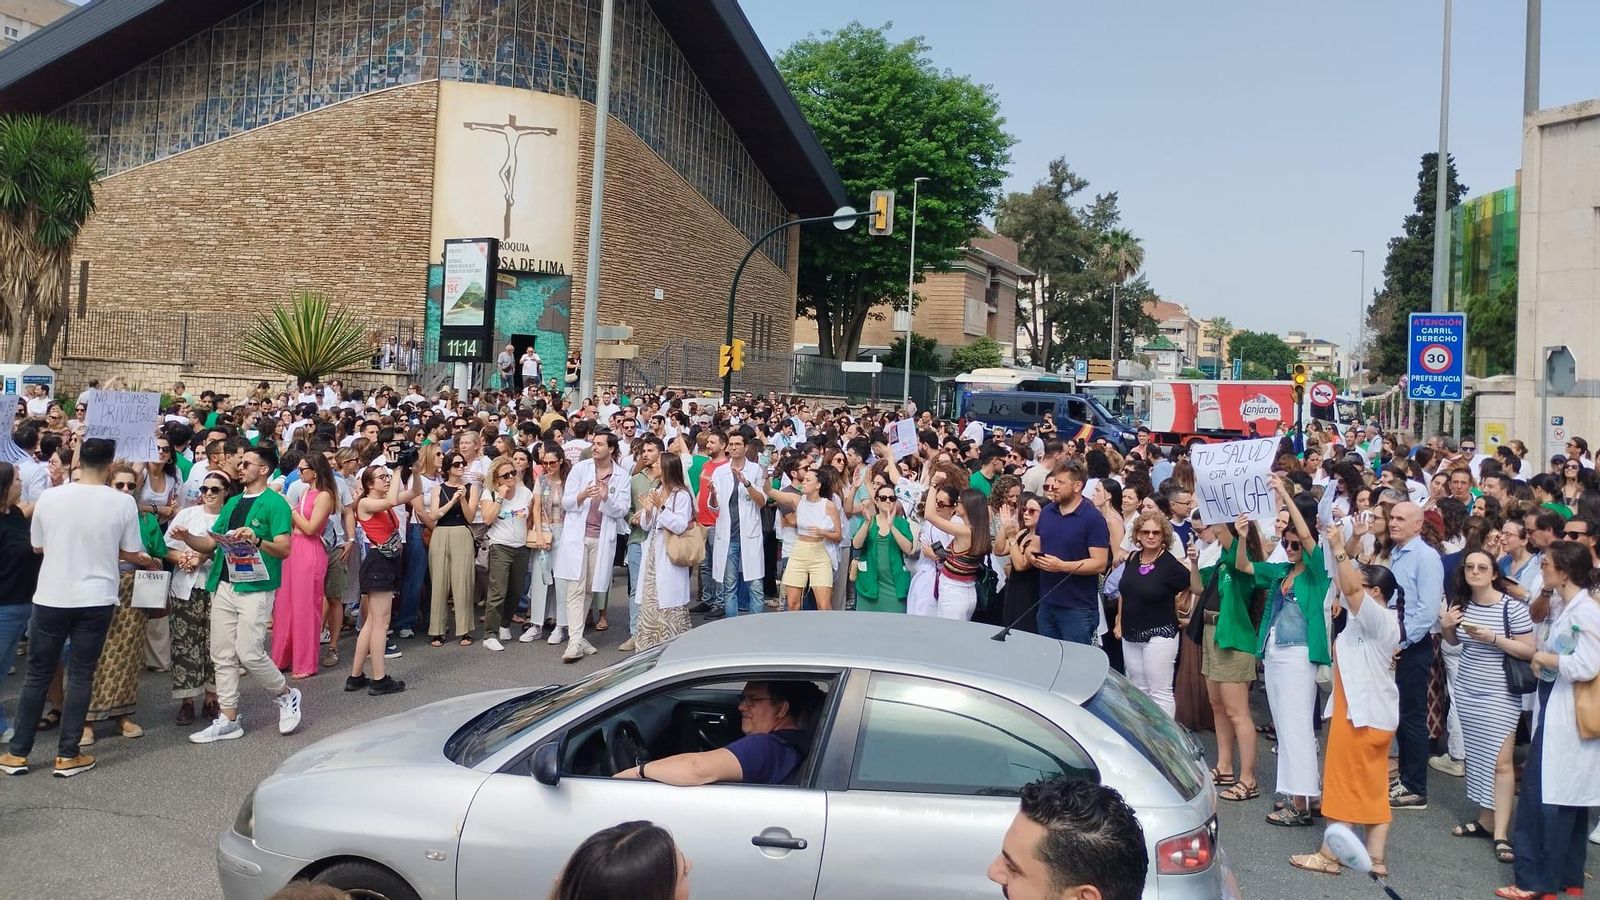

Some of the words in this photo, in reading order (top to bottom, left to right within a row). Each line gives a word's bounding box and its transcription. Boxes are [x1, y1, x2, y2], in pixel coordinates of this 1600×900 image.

[499, 241, 530, 253] ROQUIA
[520, 257, 535, 271] DE
[538, 259, 565, 275] LIMA
[1421, 327, 1453, 335] CARRIL
[447, 340, 476, 357] 11:14
[1427, 354, 1446, 363] 30
[1411, 374, 1461, 383] PREFERENCIA
[95, 391, 107, 403] NO
[1196, 450, 1215, 466] TU
[1217, 439, 1274, 467] SALUD
[1209, 469, 1227, 480] ESTA
[1233, 465, 1249, 477] EN
[1200, 475, 1271, 519] HUELGA
